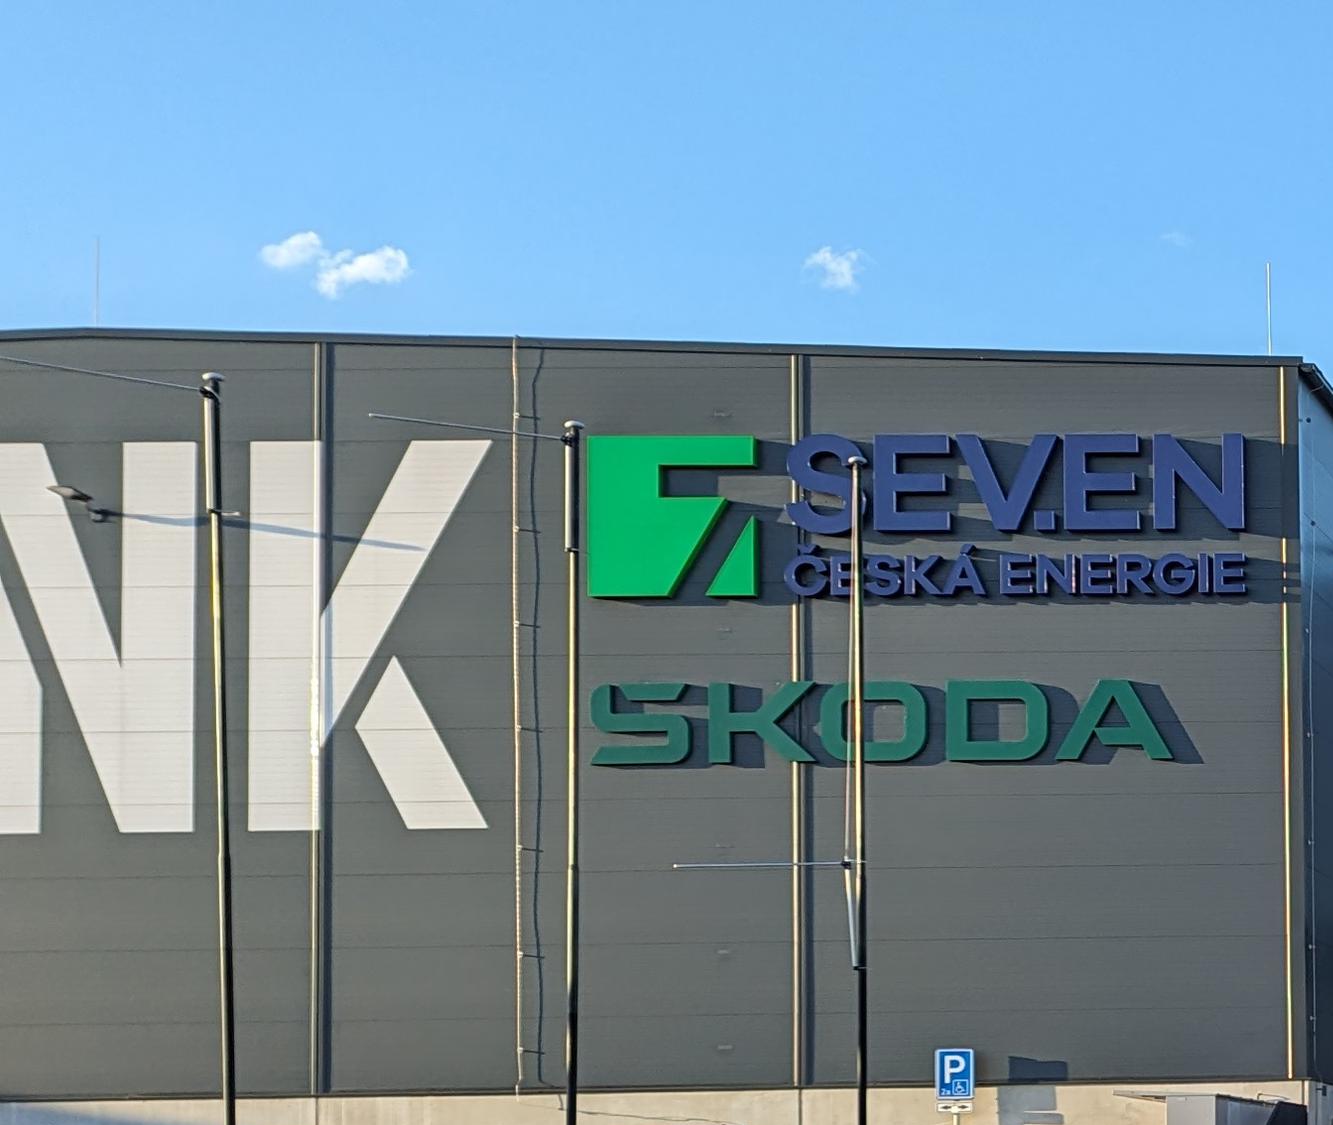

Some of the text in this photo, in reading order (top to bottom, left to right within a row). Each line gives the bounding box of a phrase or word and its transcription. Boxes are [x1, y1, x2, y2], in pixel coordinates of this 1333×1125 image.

[786, 433, 1246, 534] SEV.EN
[783, 543, 1247, 598] ČESKÁ ENERGIE
[944, 1055, 966, 1084] P
